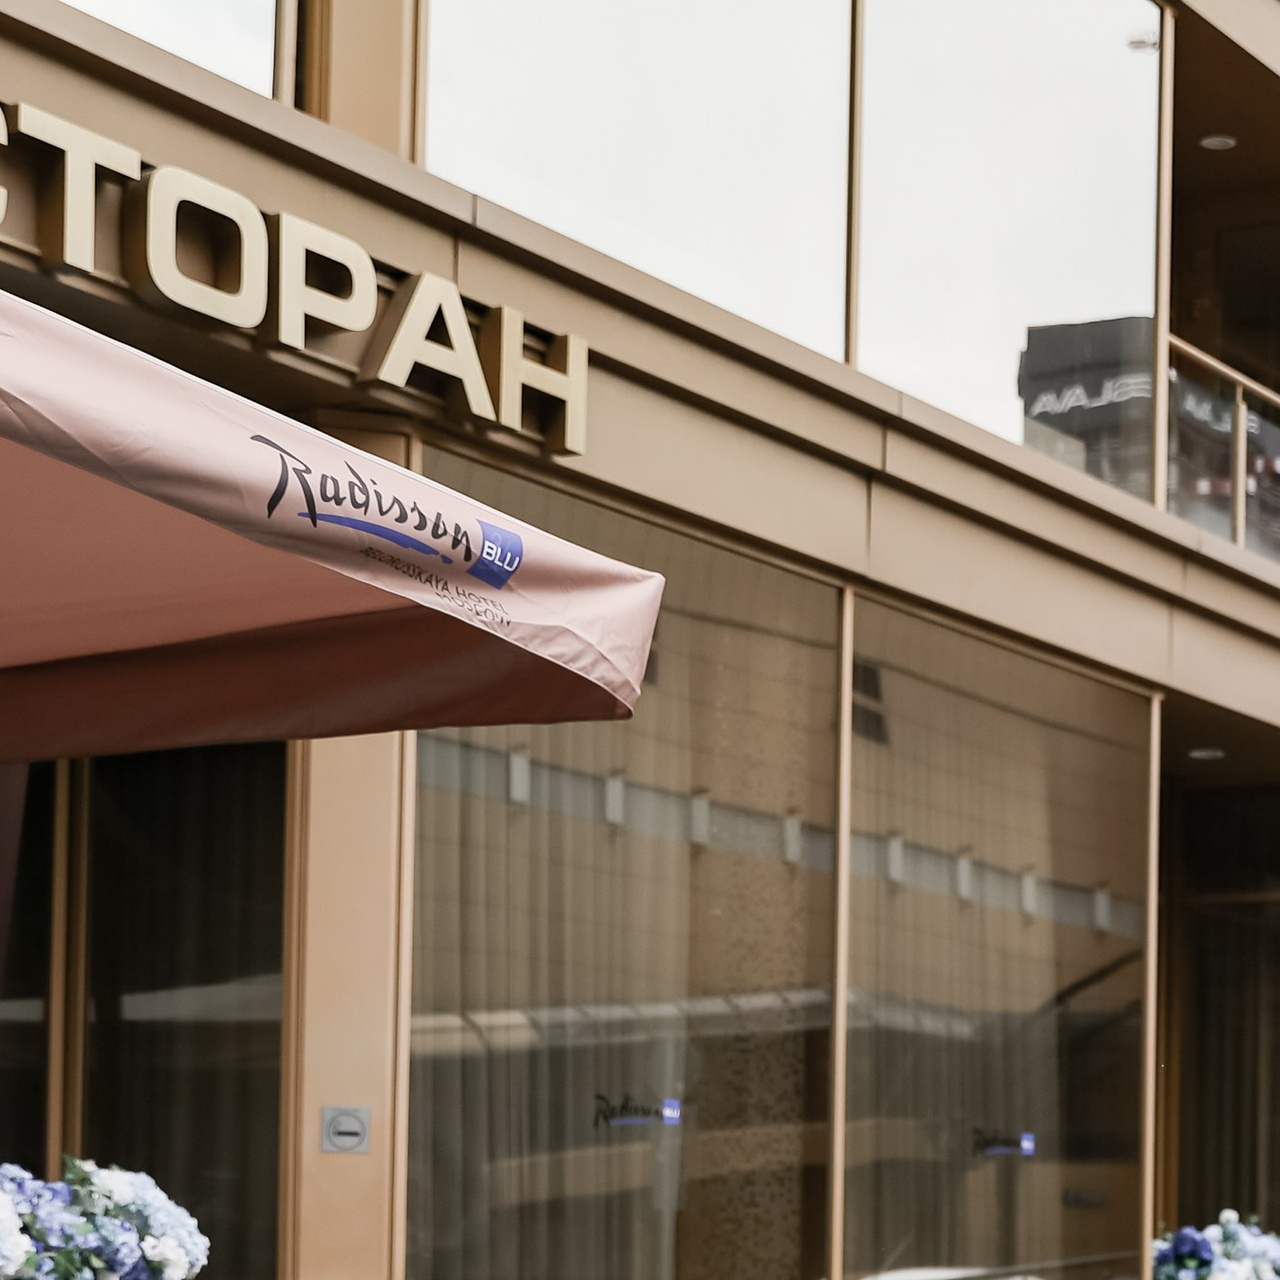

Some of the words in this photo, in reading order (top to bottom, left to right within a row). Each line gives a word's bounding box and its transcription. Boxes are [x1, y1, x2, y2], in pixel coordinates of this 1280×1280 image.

[0, 101, 590, 457] ТОРАН
[250, 434, 472, 562] Radisson
[482, 540, 520, 572] BLU
[455, 586, 509, 615] HOTEL
